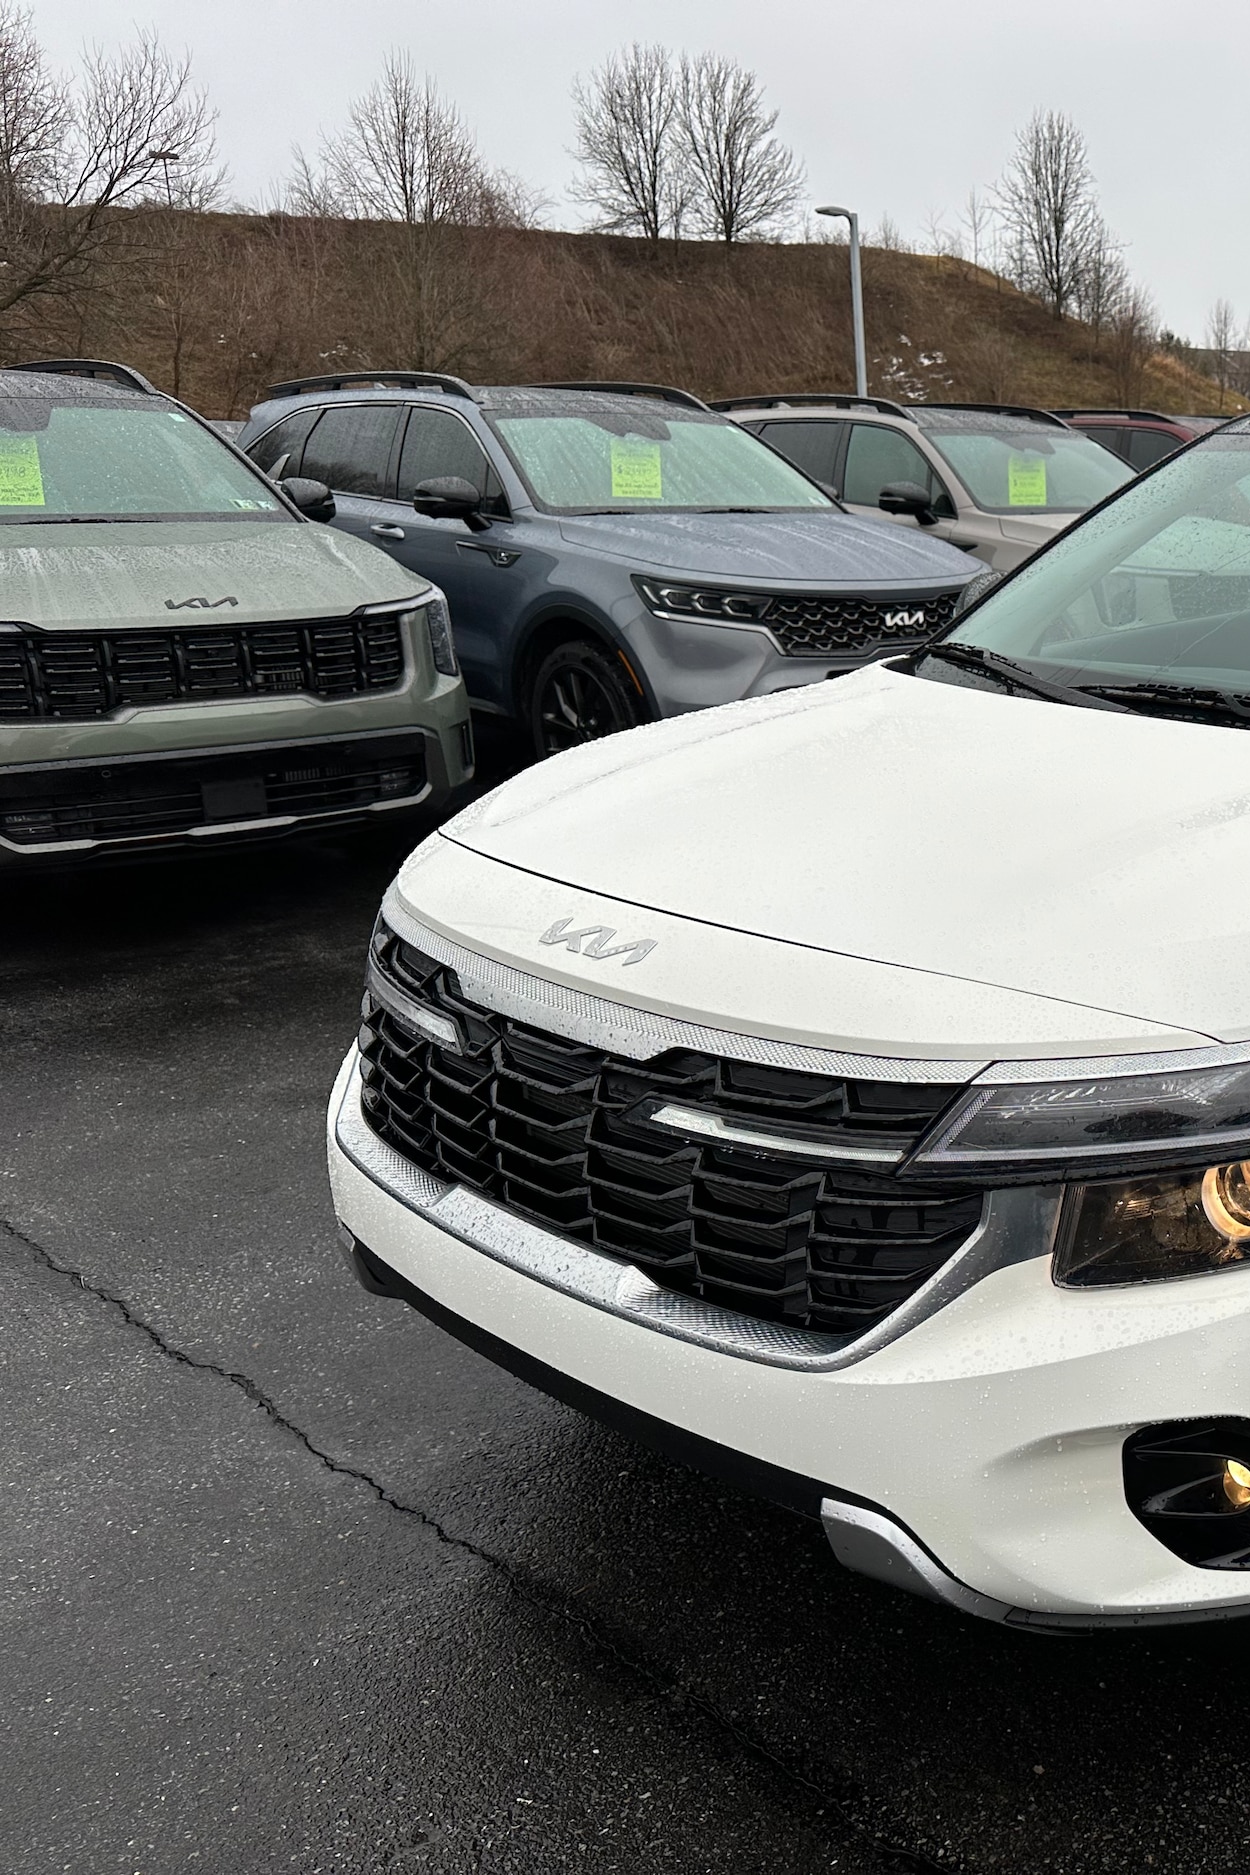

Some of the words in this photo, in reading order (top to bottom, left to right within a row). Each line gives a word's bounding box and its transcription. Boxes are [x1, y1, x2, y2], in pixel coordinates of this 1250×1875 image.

[164, 596, 239, 610] KIA
[884, 610, 925, 627] KIA
[538, 916, 659, 967] KIA
